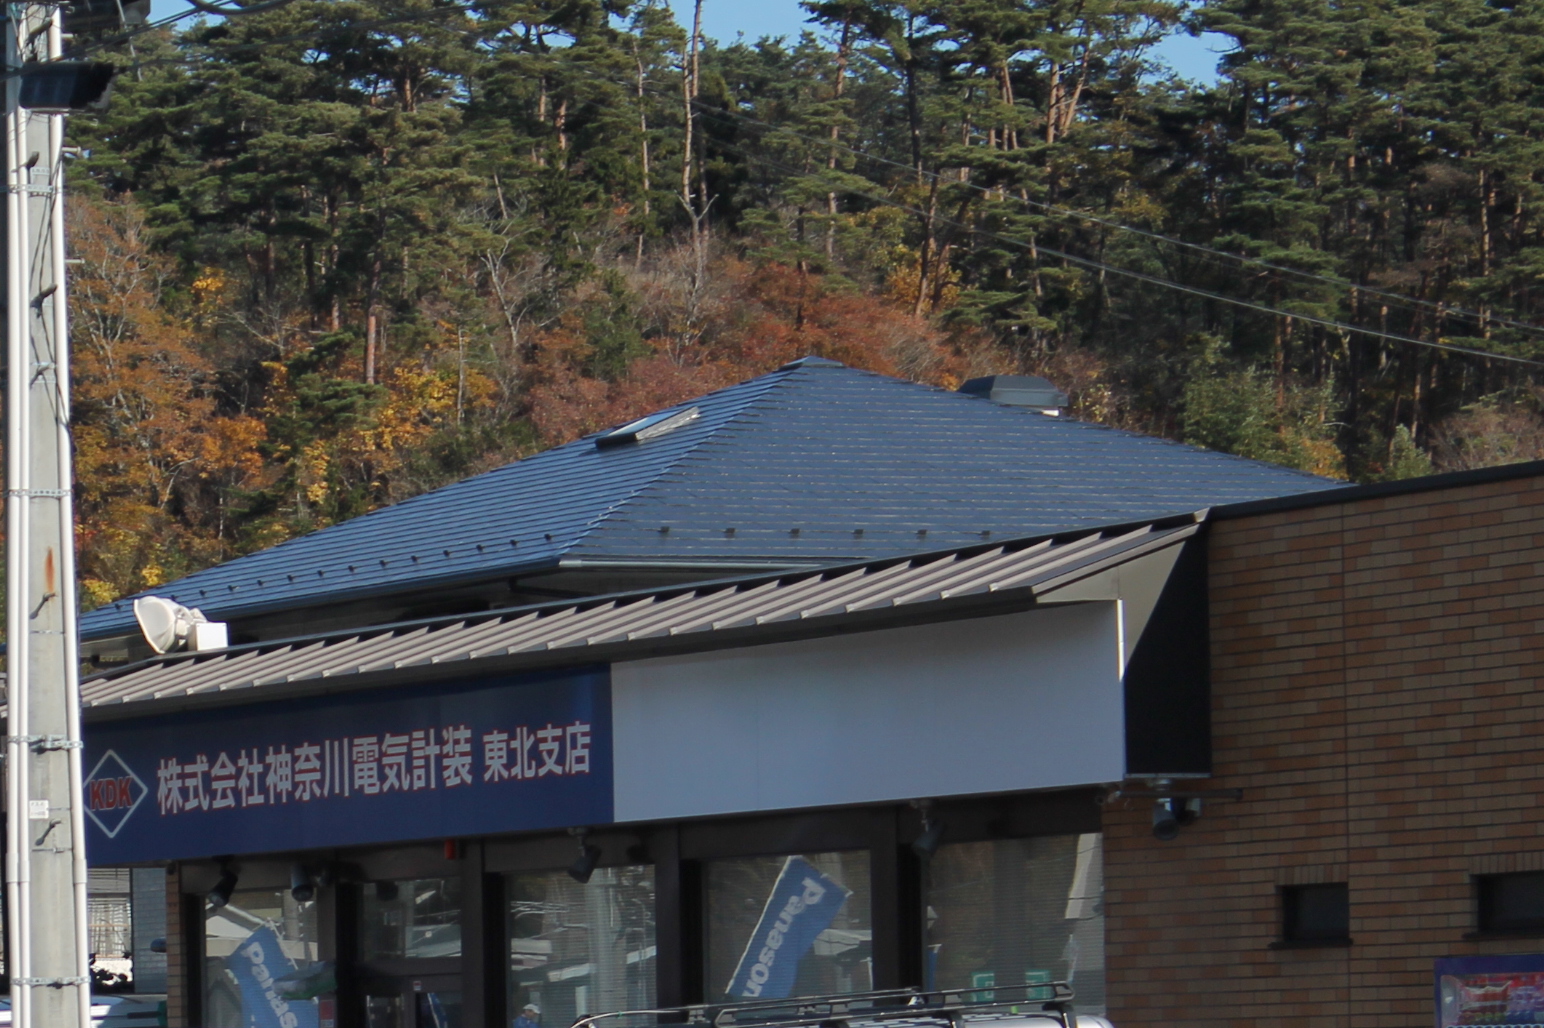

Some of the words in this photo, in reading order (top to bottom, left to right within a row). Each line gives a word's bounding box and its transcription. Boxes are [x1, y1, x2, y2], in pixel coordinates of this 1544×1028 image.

[89, 776, 133, 811] KDK
[157, 725, 473, 816] 株式会社神奈川電気計装
[483, 720, 592, 783] 東北支店
